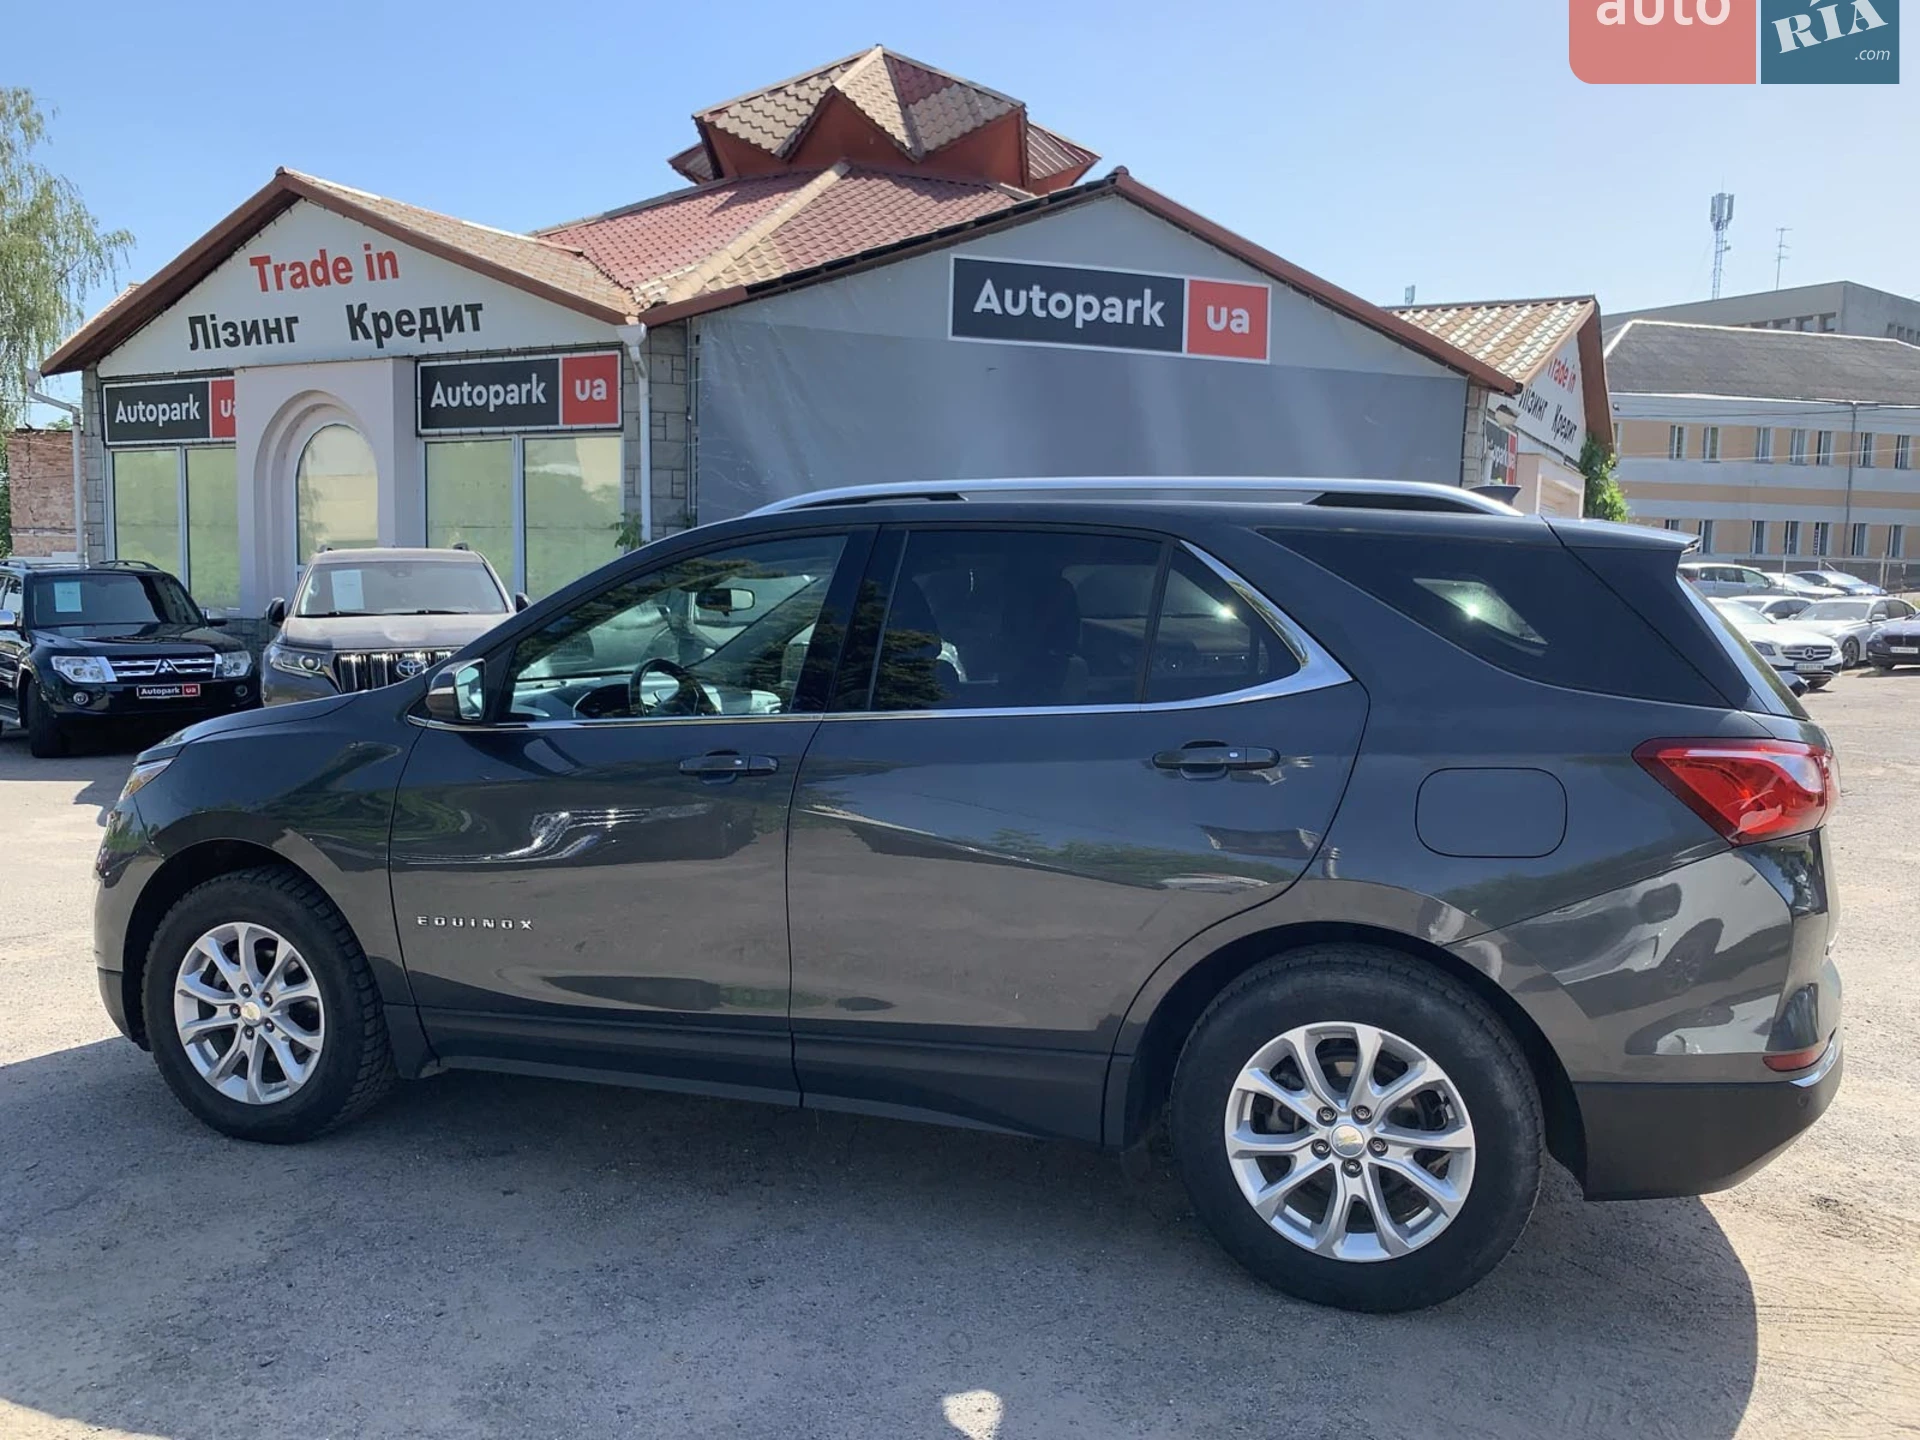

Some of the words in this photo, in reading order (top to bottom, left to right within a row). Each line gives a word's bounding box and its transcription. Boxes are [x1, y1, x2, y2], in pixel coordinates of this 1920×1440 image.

[249, 249, 353, 293] Trade
[363, 243, 399, 281] in
[188, 313, 299, 351] Лізинг
[346, 302, 483, 349] Кредит
[973, 278, 1165, 329] Autopark
[1206, 305, 1250, 334] ua
[114, 393, 201, 427] Autopark
[220, 398, 236, 418] u
[430, 373, 546, 412] Autopark
[575, 378, 608, 402] ua
[140, 686, 181, 696] Autopark
